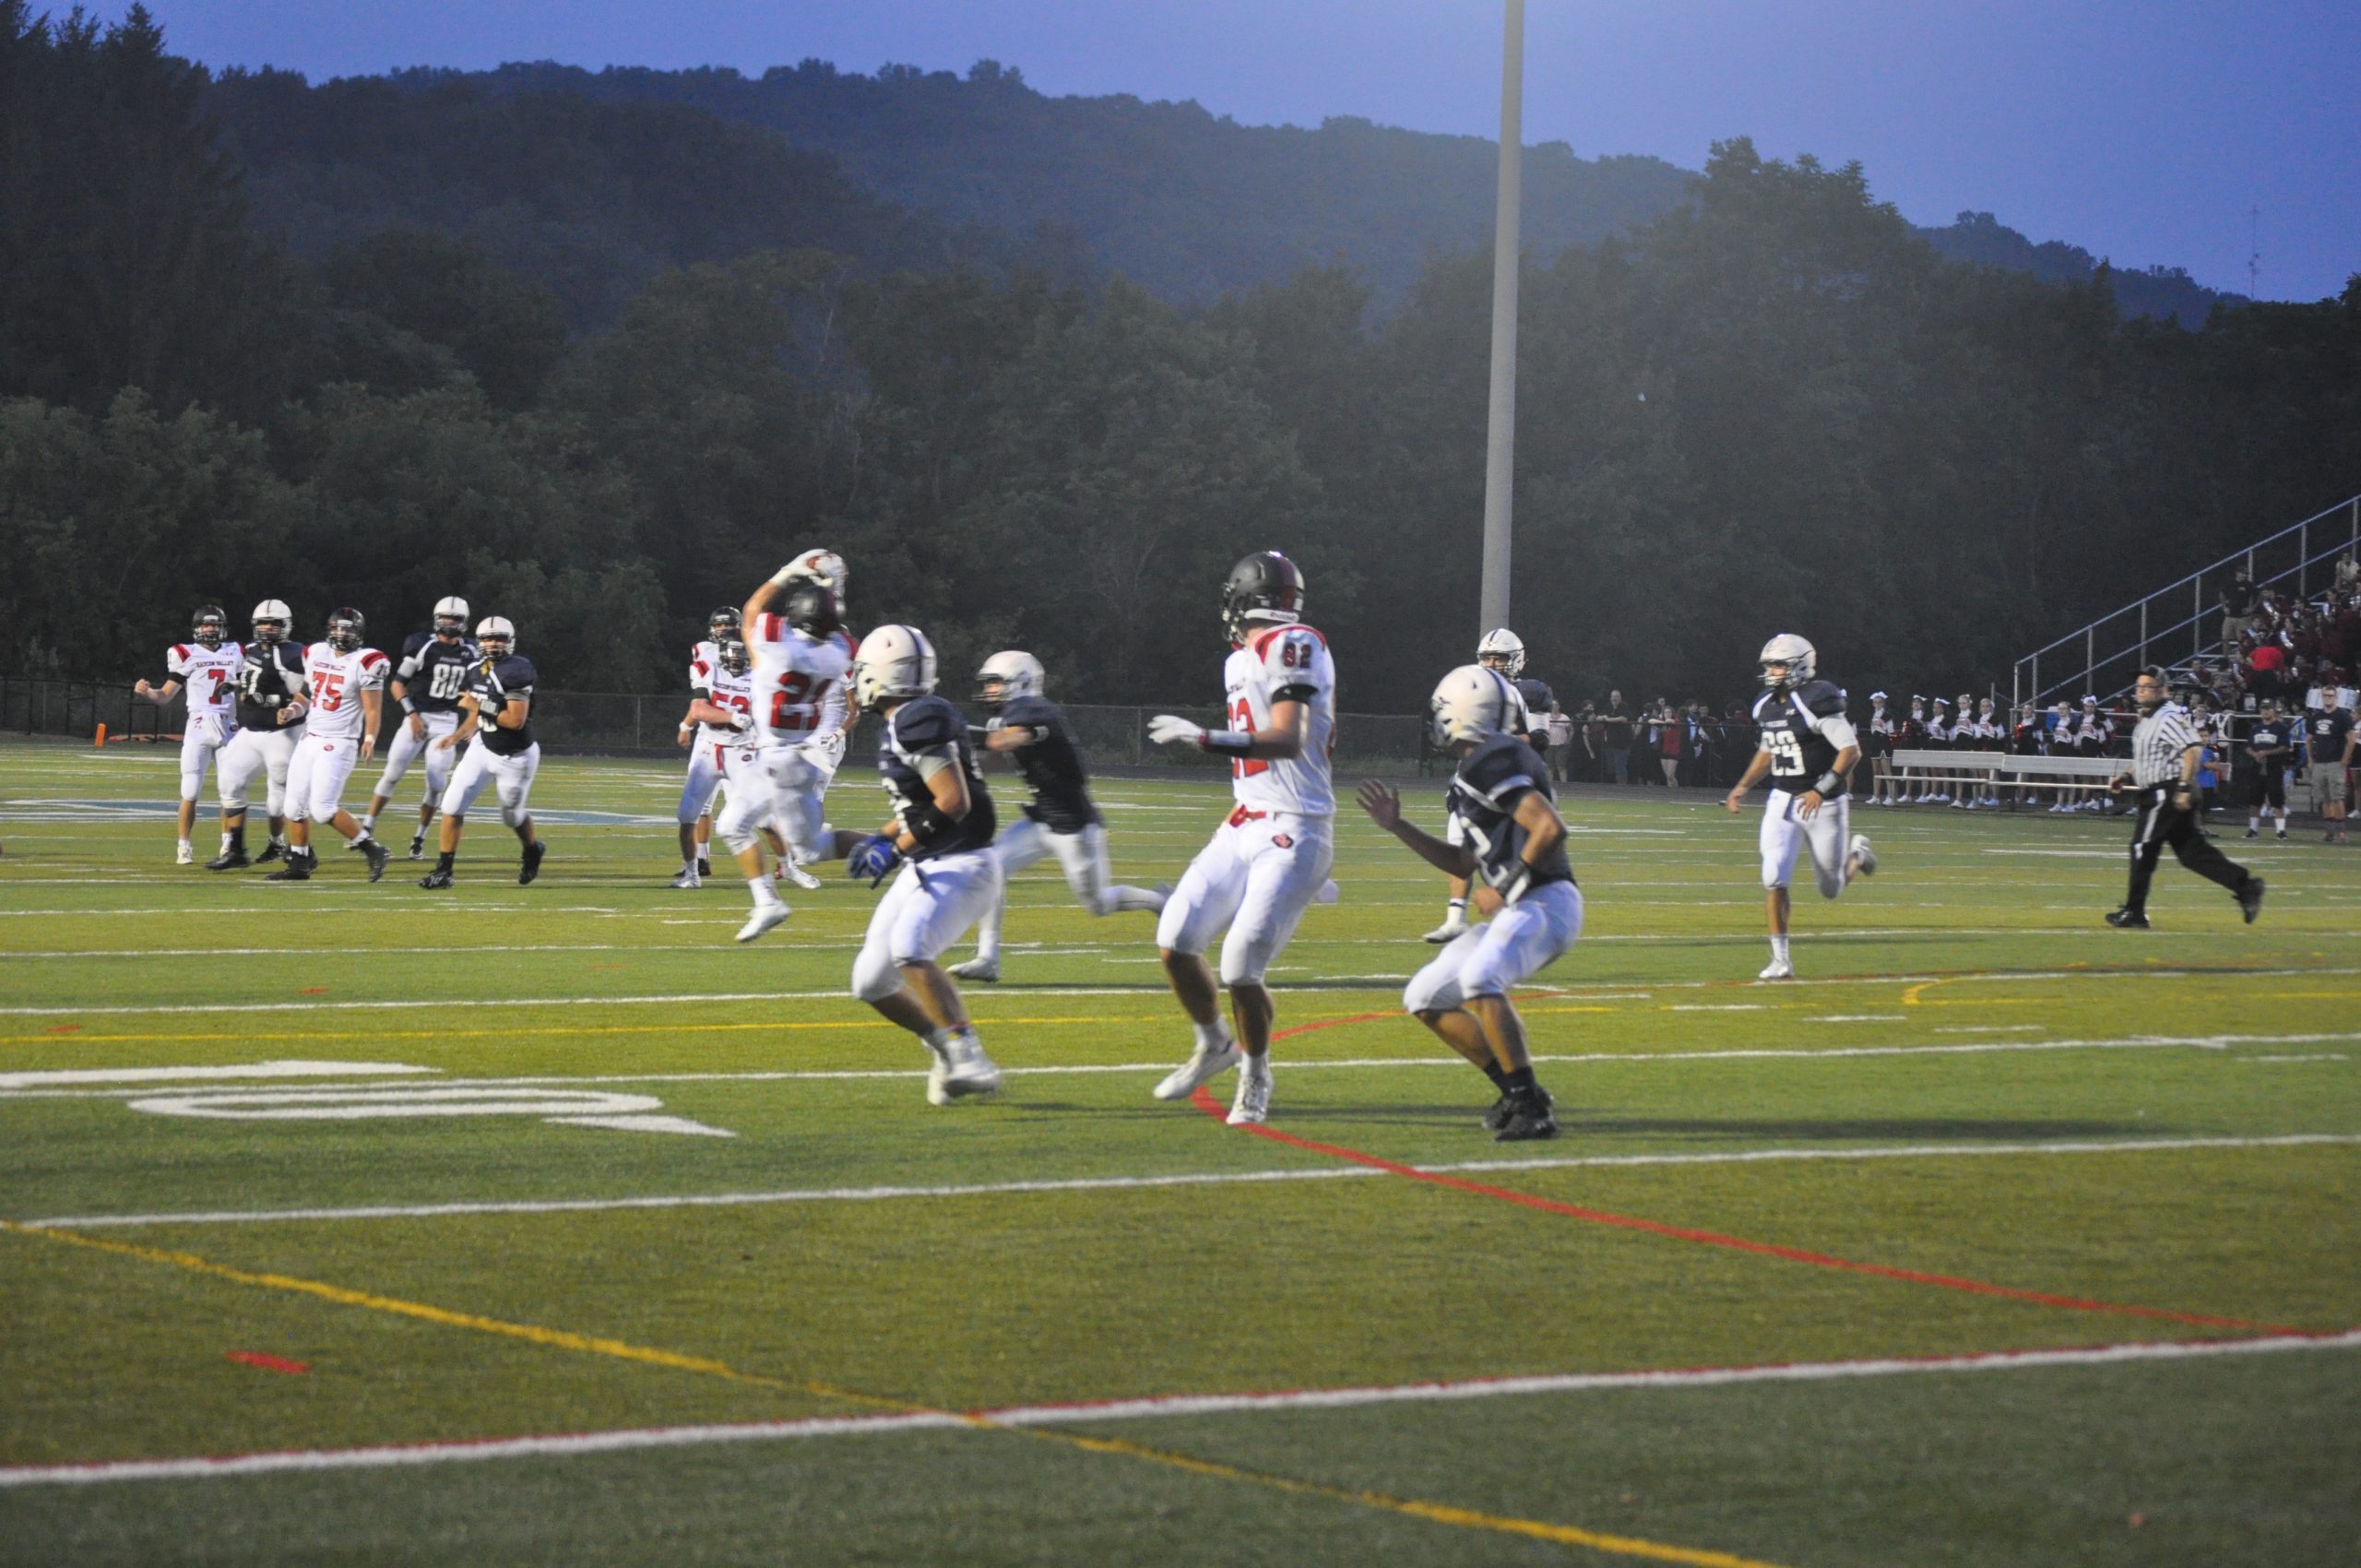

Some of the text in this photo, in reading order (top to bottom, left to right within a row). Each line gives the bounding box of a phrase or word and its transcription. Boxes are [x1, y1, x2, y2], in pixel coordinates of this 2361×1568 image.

[1282, 641, 1312, 669] 82
[208, 669, 226, 705] 7
[311, 671, 345, 712] 75
[429, 663, 466, 700] 80
[1762, 730, 1806, 776] 29
